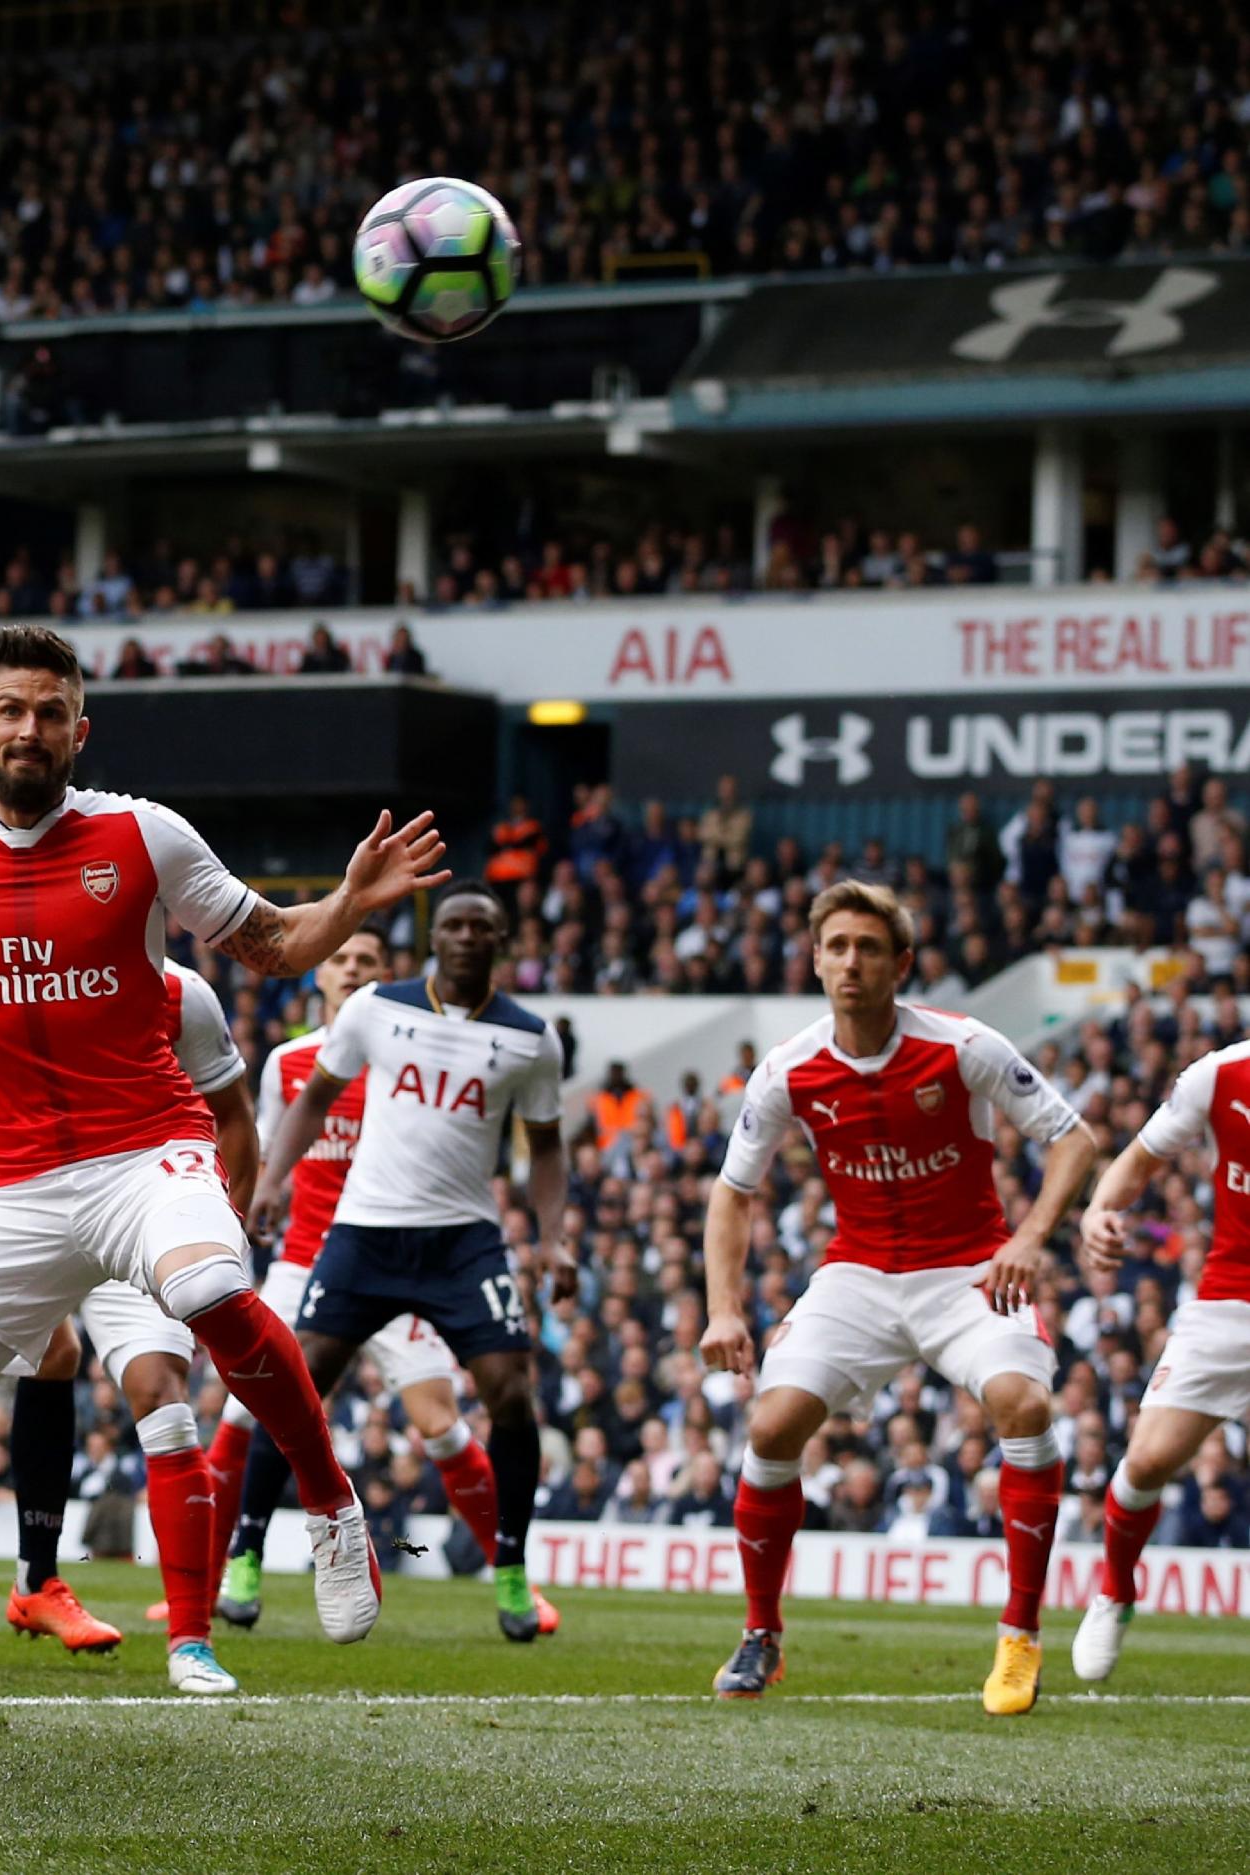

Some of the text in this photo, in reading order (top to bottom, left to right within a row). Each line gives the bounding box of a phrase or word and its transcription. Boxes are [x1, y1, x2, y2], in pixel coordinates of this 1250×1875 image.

[607, 626, 733, 684] AIA
[957, 617, 1042, 676] THE
[1054, 615, 1171, 673] REAL
[0, 936, 53, 966] Fly
[390, 1063, 485, 1120] AIA
